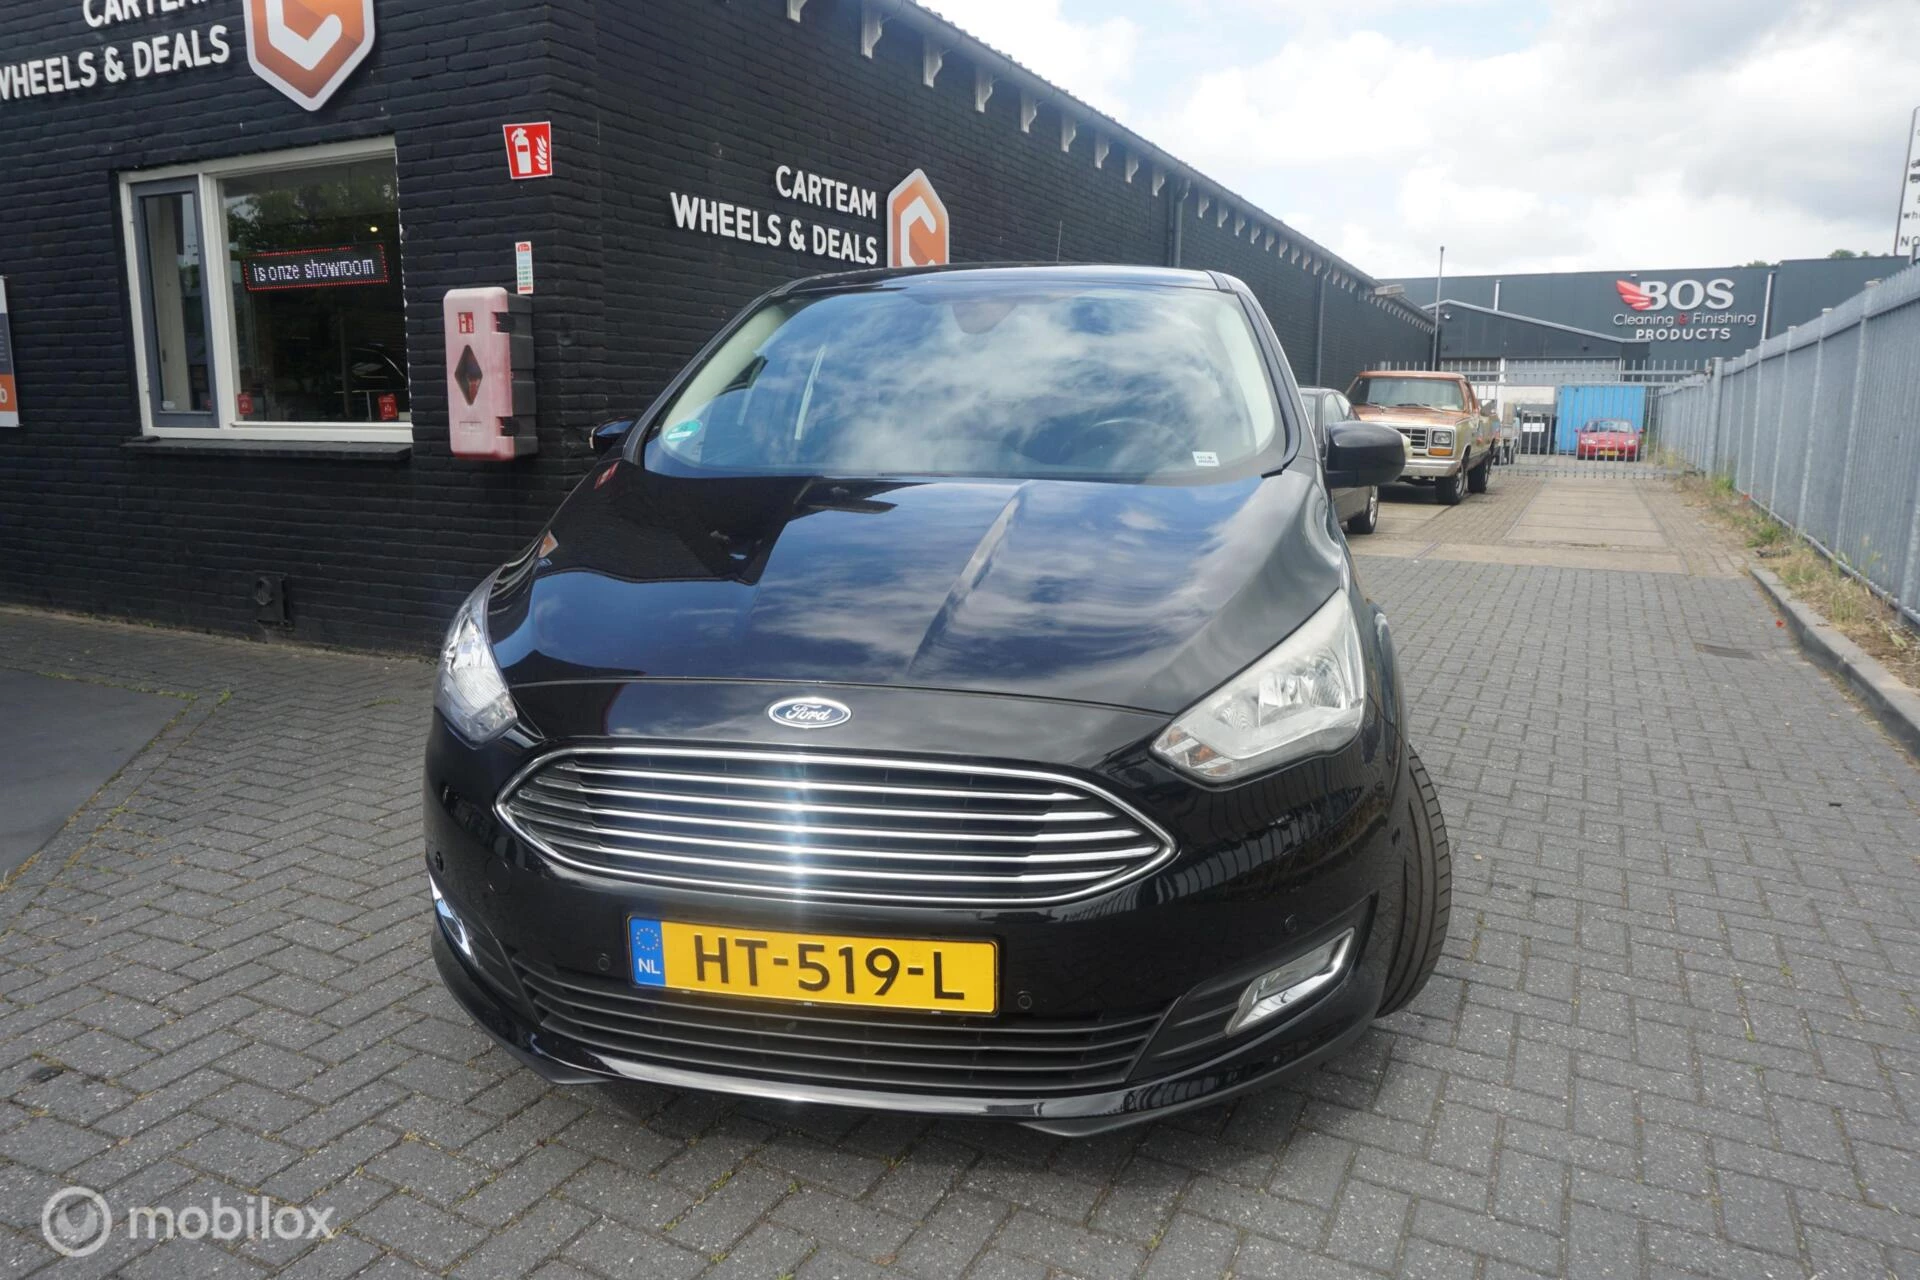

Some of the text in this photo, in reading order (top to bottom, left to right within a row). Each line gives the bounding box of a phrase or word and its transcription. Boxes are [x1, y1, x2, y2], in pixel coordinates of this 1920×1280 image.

[104, 46, 127, 83] &
[132, 25, 230, 77] DEALS
[775, 165, 877, 219] CARTEAM
[670, 192, 878, 265] WHEELS & DEALS
[253, 258, 375, 282] is onze showroom
[1639, 278, 1735, 311] BOS
[1613, 312, 1756, 327] Cleaning & Finishing
[1635, 327, 1731, 341] PRODUCTS
[785, 703, 832, 721] Ford
[638, 957, 661, 975] NL
[694, 934, 965, 1001] HT-519-L
